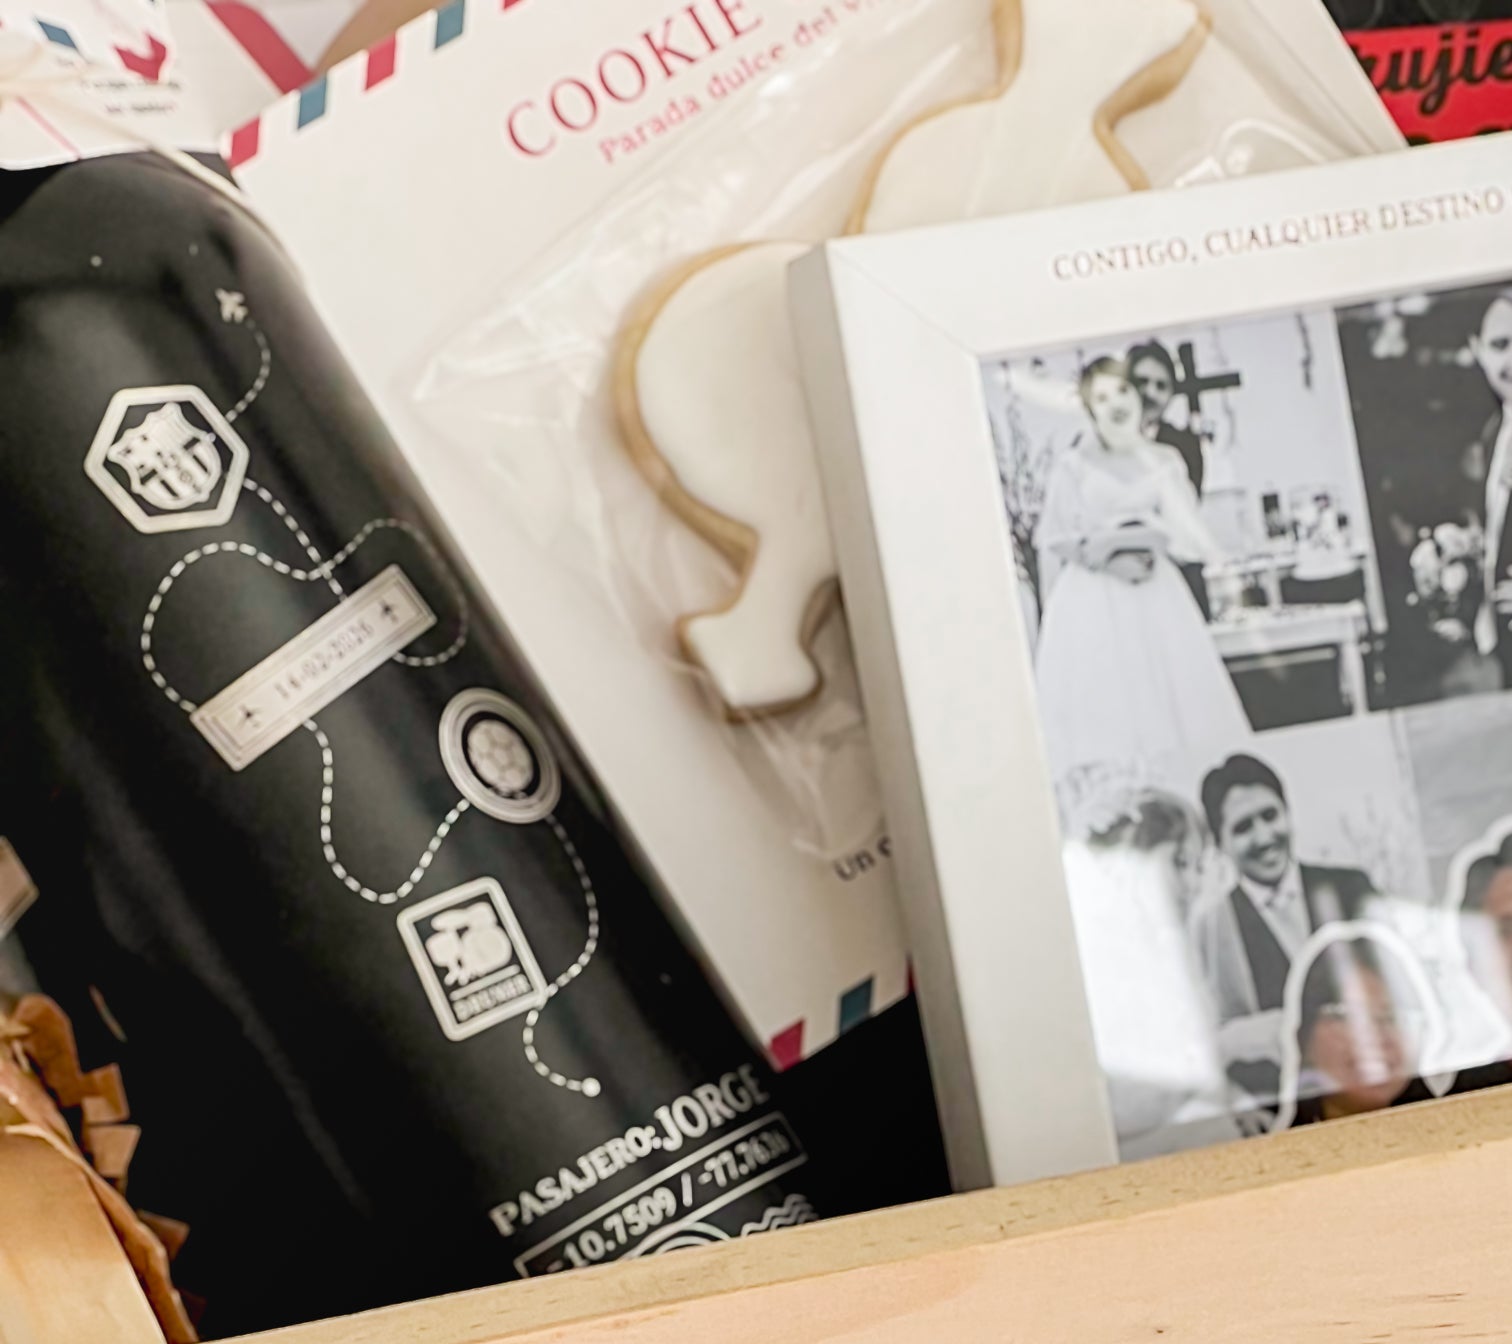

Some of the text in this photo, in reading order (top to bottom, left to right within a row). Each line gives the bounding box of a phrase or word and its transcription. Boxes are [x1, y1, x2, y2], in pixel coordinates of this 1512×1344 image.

[507, 0, 763, 157] COOKIE
[598, 94, 701, 164] Parada
[707, 43, 785, 101] dulce
[1053, 236, 1198, 282] CONTIGO,
[1204, 206, 1372, 258] CUALQUIER
[1380, 186, 1506, 232] DESTINO
[488, 1064, 770, 1237] PASAJERO: JORGE
